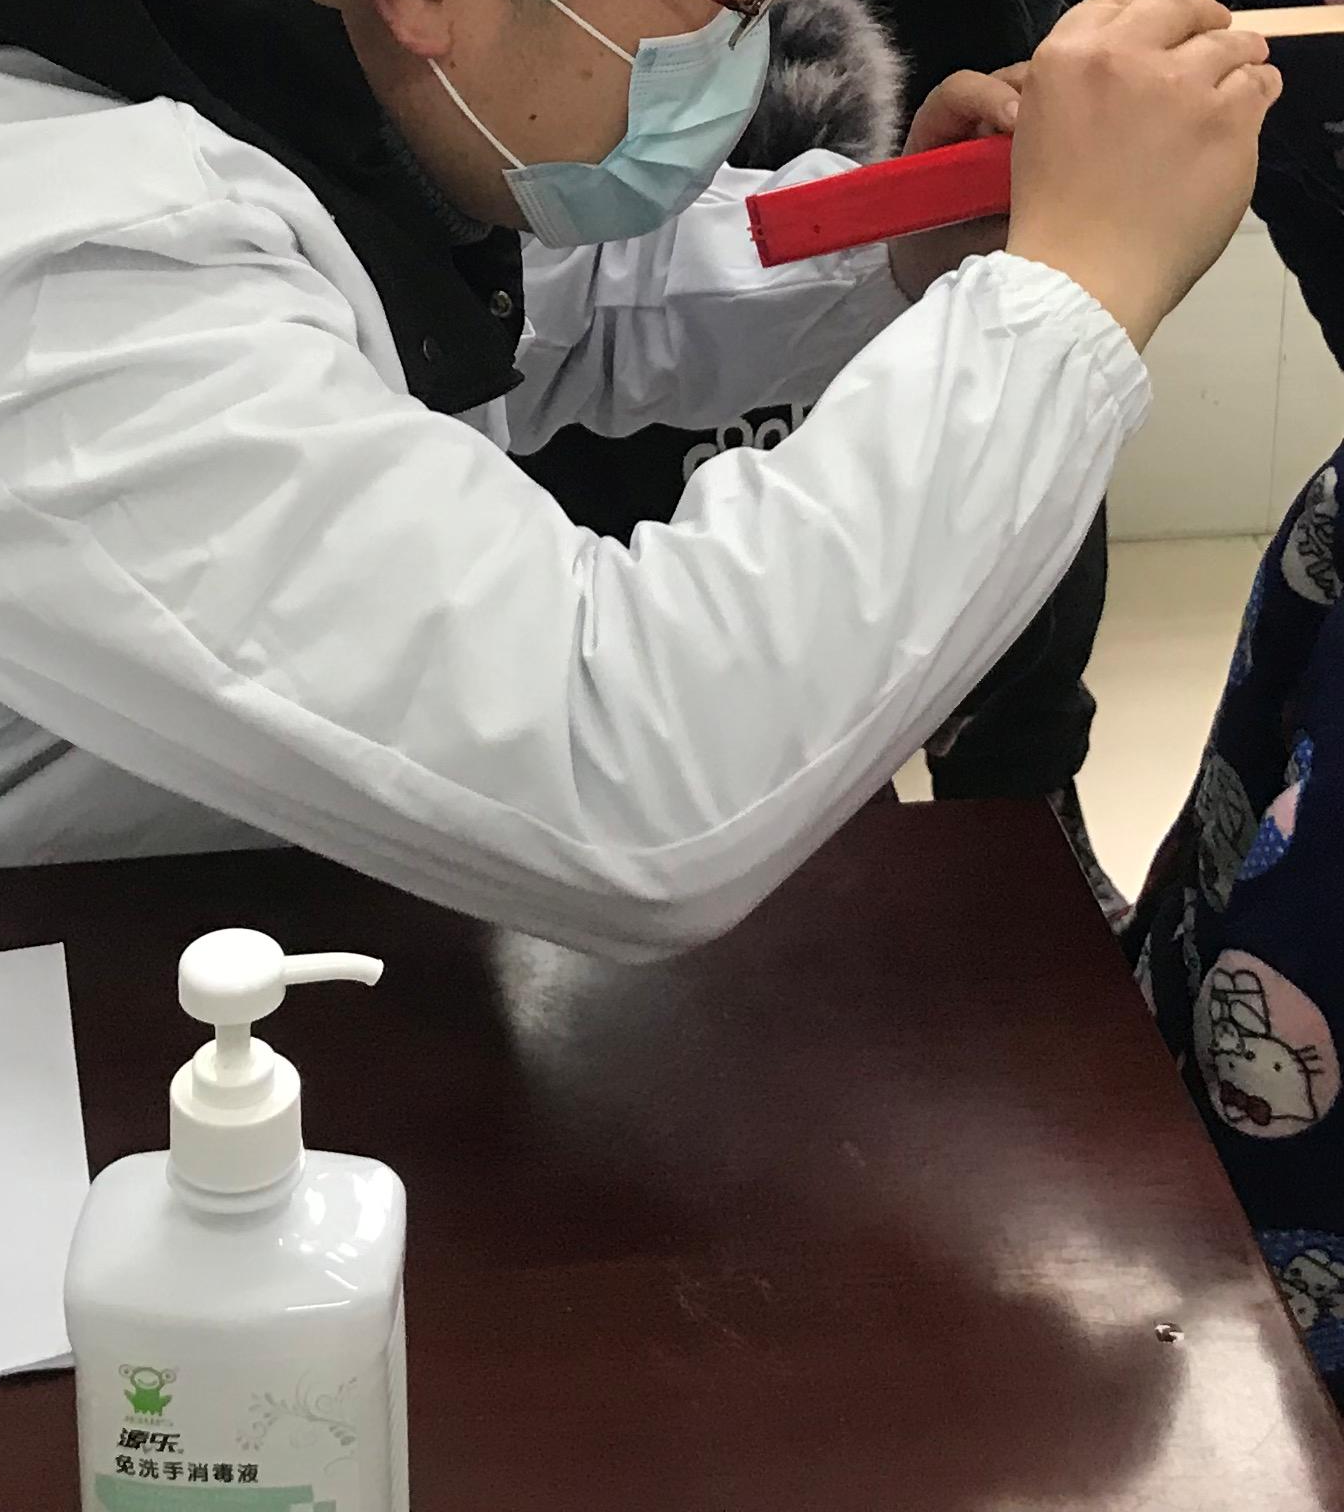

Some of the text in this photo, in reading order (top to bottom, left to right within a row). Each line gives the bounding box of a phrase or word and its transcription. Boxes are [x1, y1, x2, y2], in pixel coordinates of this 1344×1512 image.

[115, 1427, 181, 1453] 源乐
[114, 1454, 259, 1484] 免洗手消毒液
